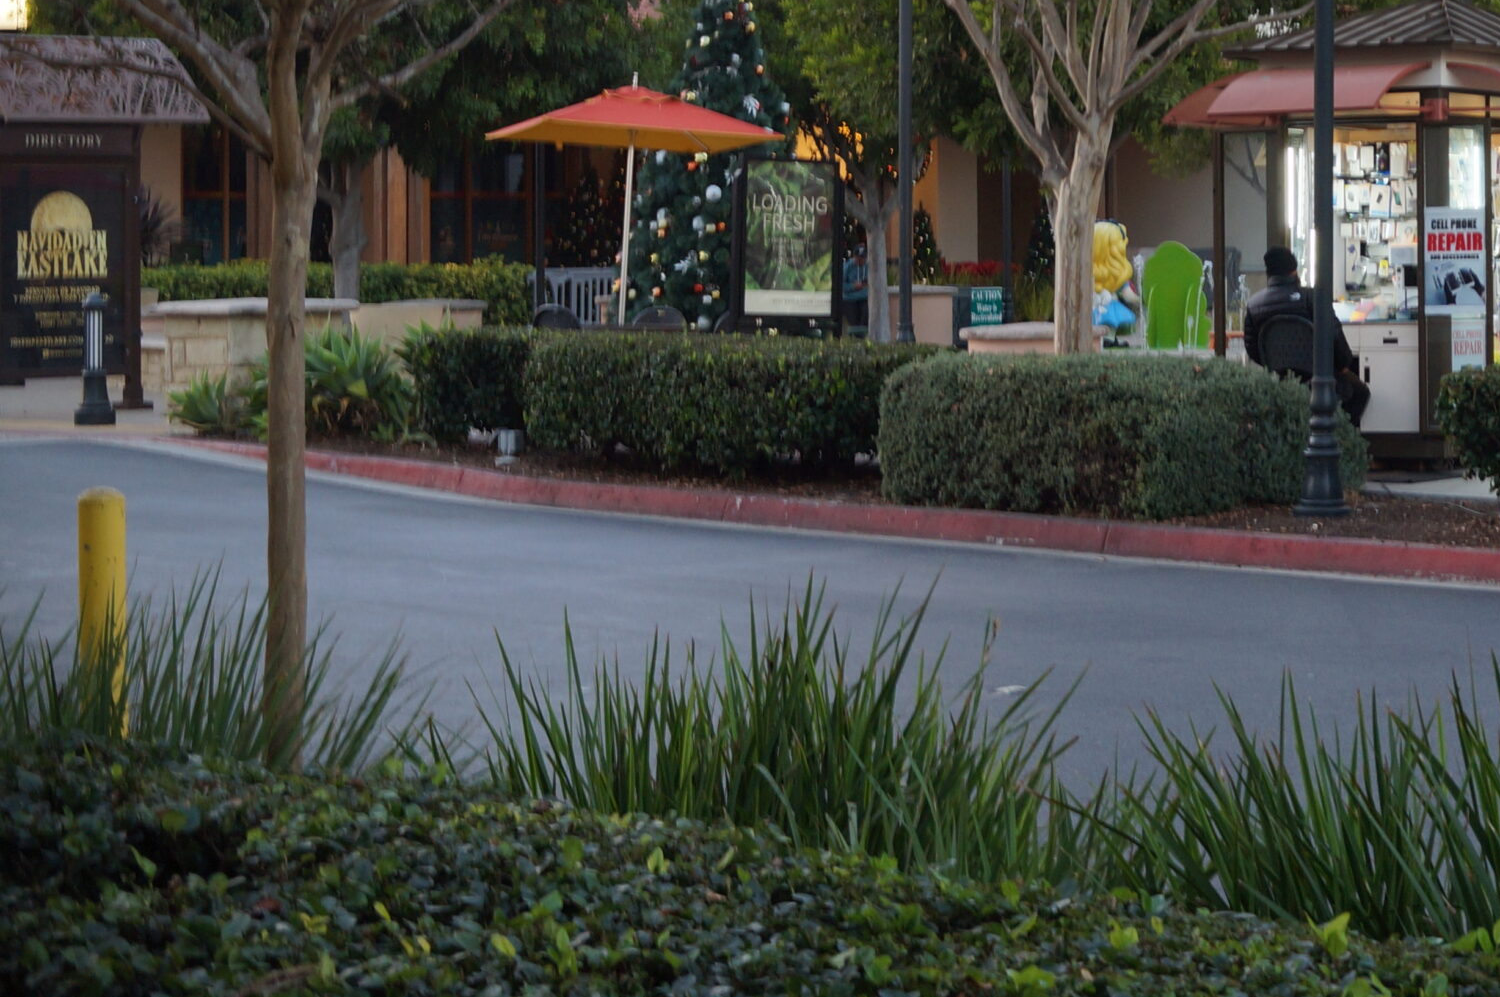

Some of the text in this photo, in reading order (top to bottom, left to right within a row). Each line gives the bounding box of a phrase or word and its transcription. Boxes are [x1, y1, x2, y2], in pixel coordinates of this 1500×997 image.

[25, 133, 102, 148] DIRECTORY
[752, 193, 828, 216] LOADING
[763, 212, 815, 234] FRESH
[1431, 218, 1477, 230] CELL PHONE
[17, 229, 84, 253] NAVIDAD
[1427, 232, 1483, 252] REPAIR
[17, 250, 108, 279] EASTLAKE
[971, 290, 1002, 301] CAUTION
[1452, 330, 1466, 339] CELL
[1454, 340, 1482, 356] REPAIR
